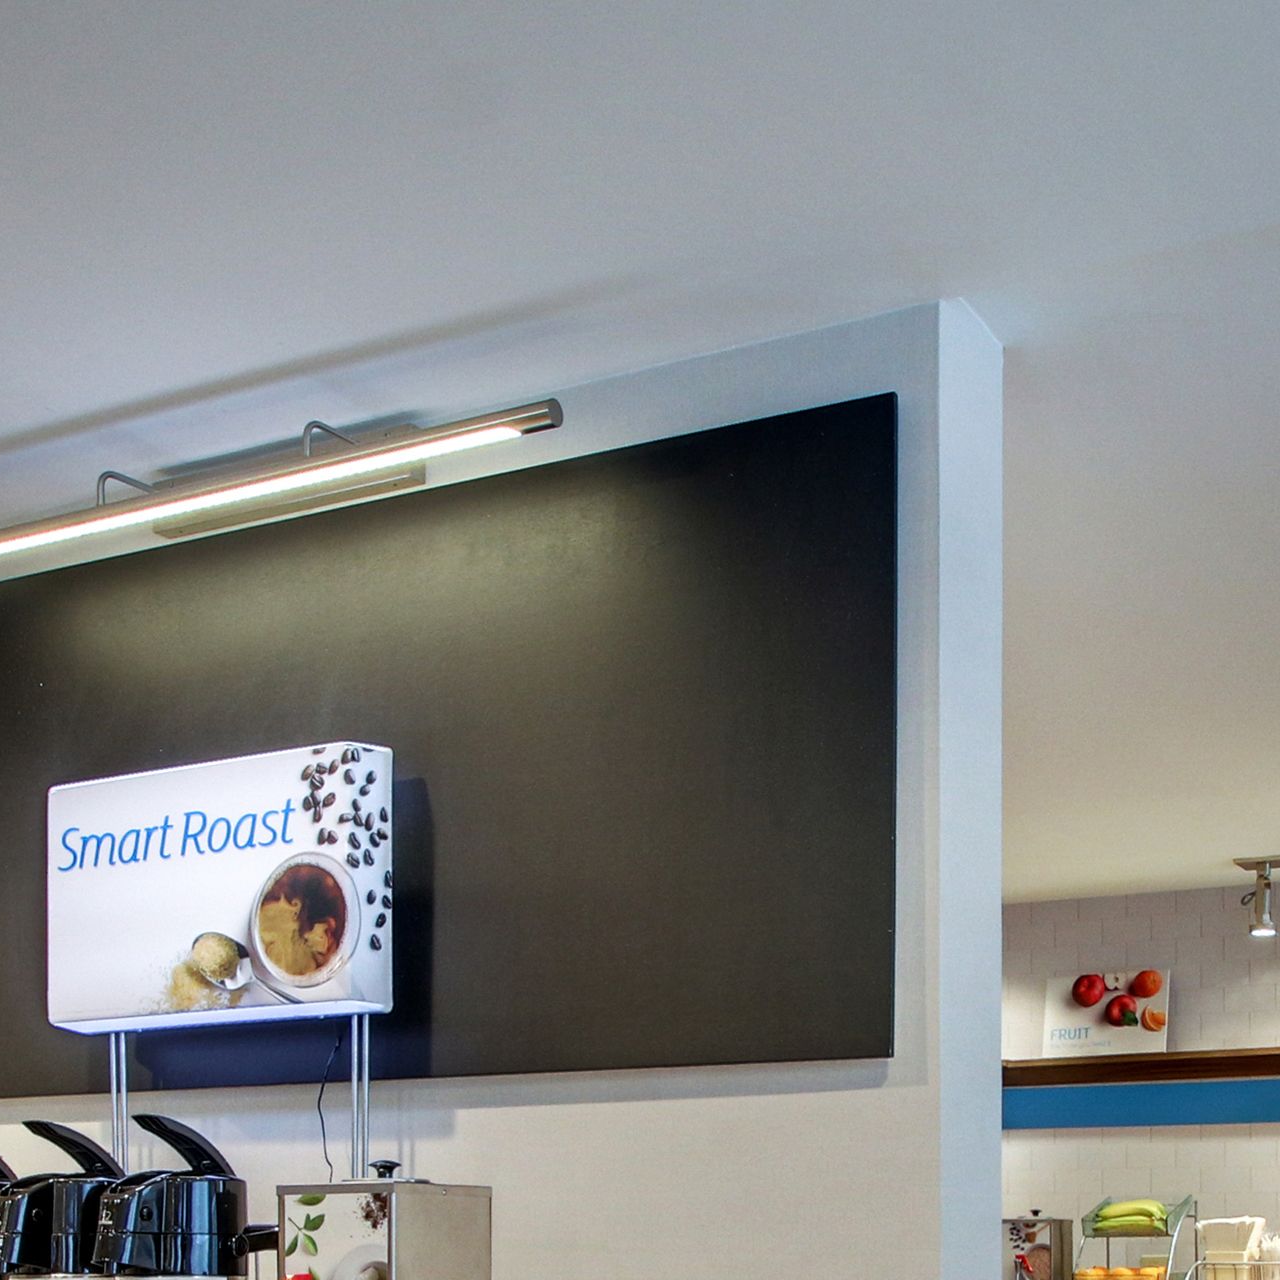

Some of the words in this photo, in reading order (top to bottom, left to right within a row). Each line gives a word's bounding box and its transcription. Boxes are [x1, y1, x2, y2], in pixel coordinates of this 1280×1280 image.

[57, 814, 173, 872] Smart
[180, 798, 296, 857] Roast
[1050, 1027, 1091, 1041] FRUIT
